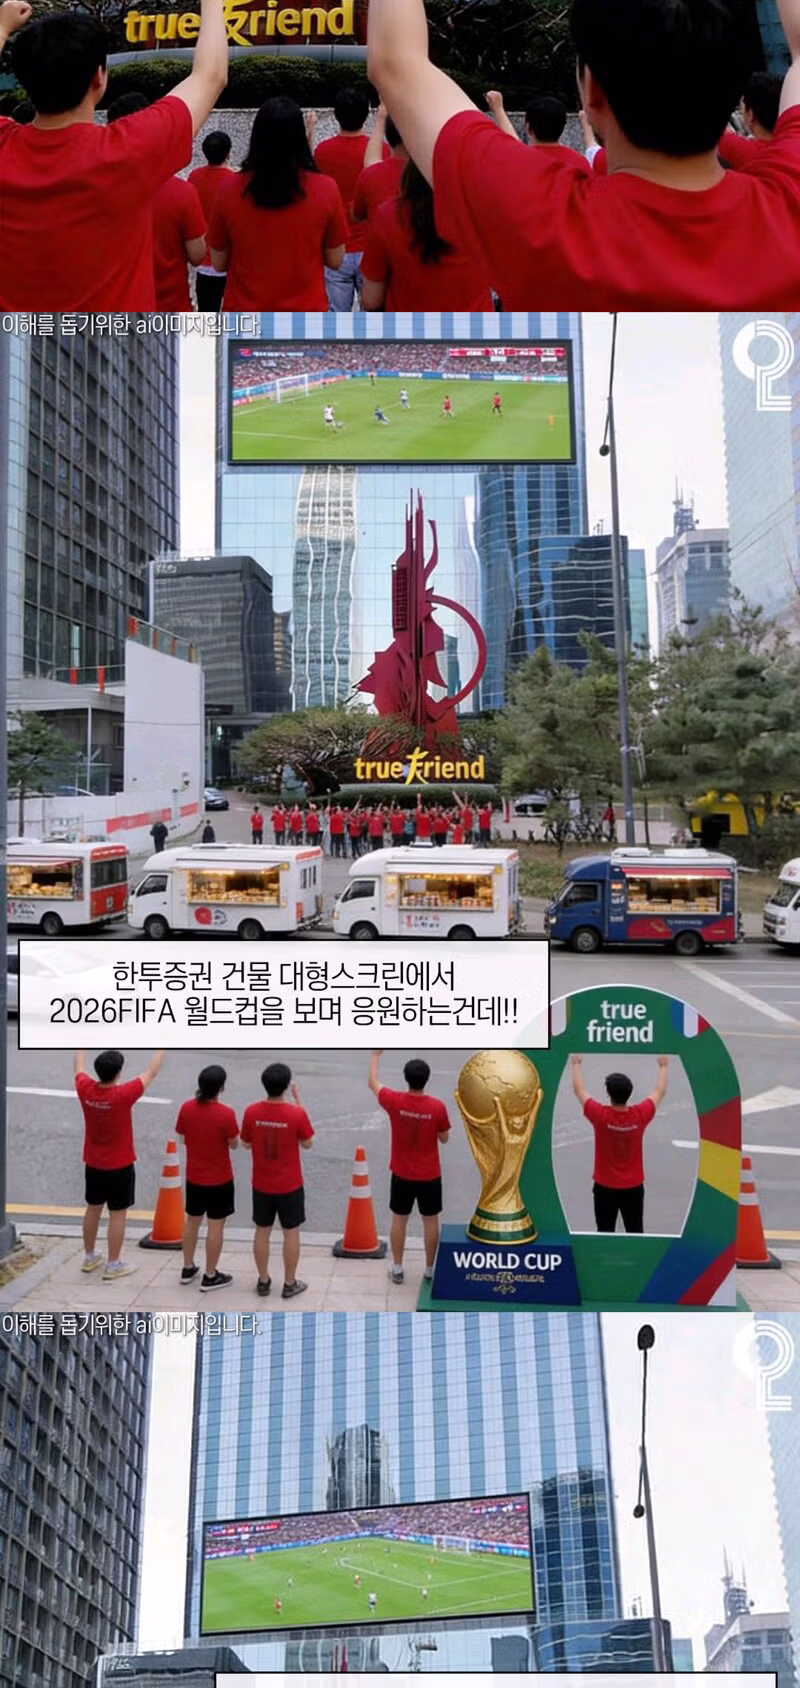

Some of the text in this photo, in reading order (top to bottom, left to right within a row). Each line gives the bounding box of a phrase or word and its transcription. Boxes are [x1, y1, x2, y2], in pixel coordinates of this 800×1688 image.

[600, 1000, 647, 1019] true
[587, 1019, 654, 1043] friend
[453, 1251, 562, 1271] WORLD CUP
